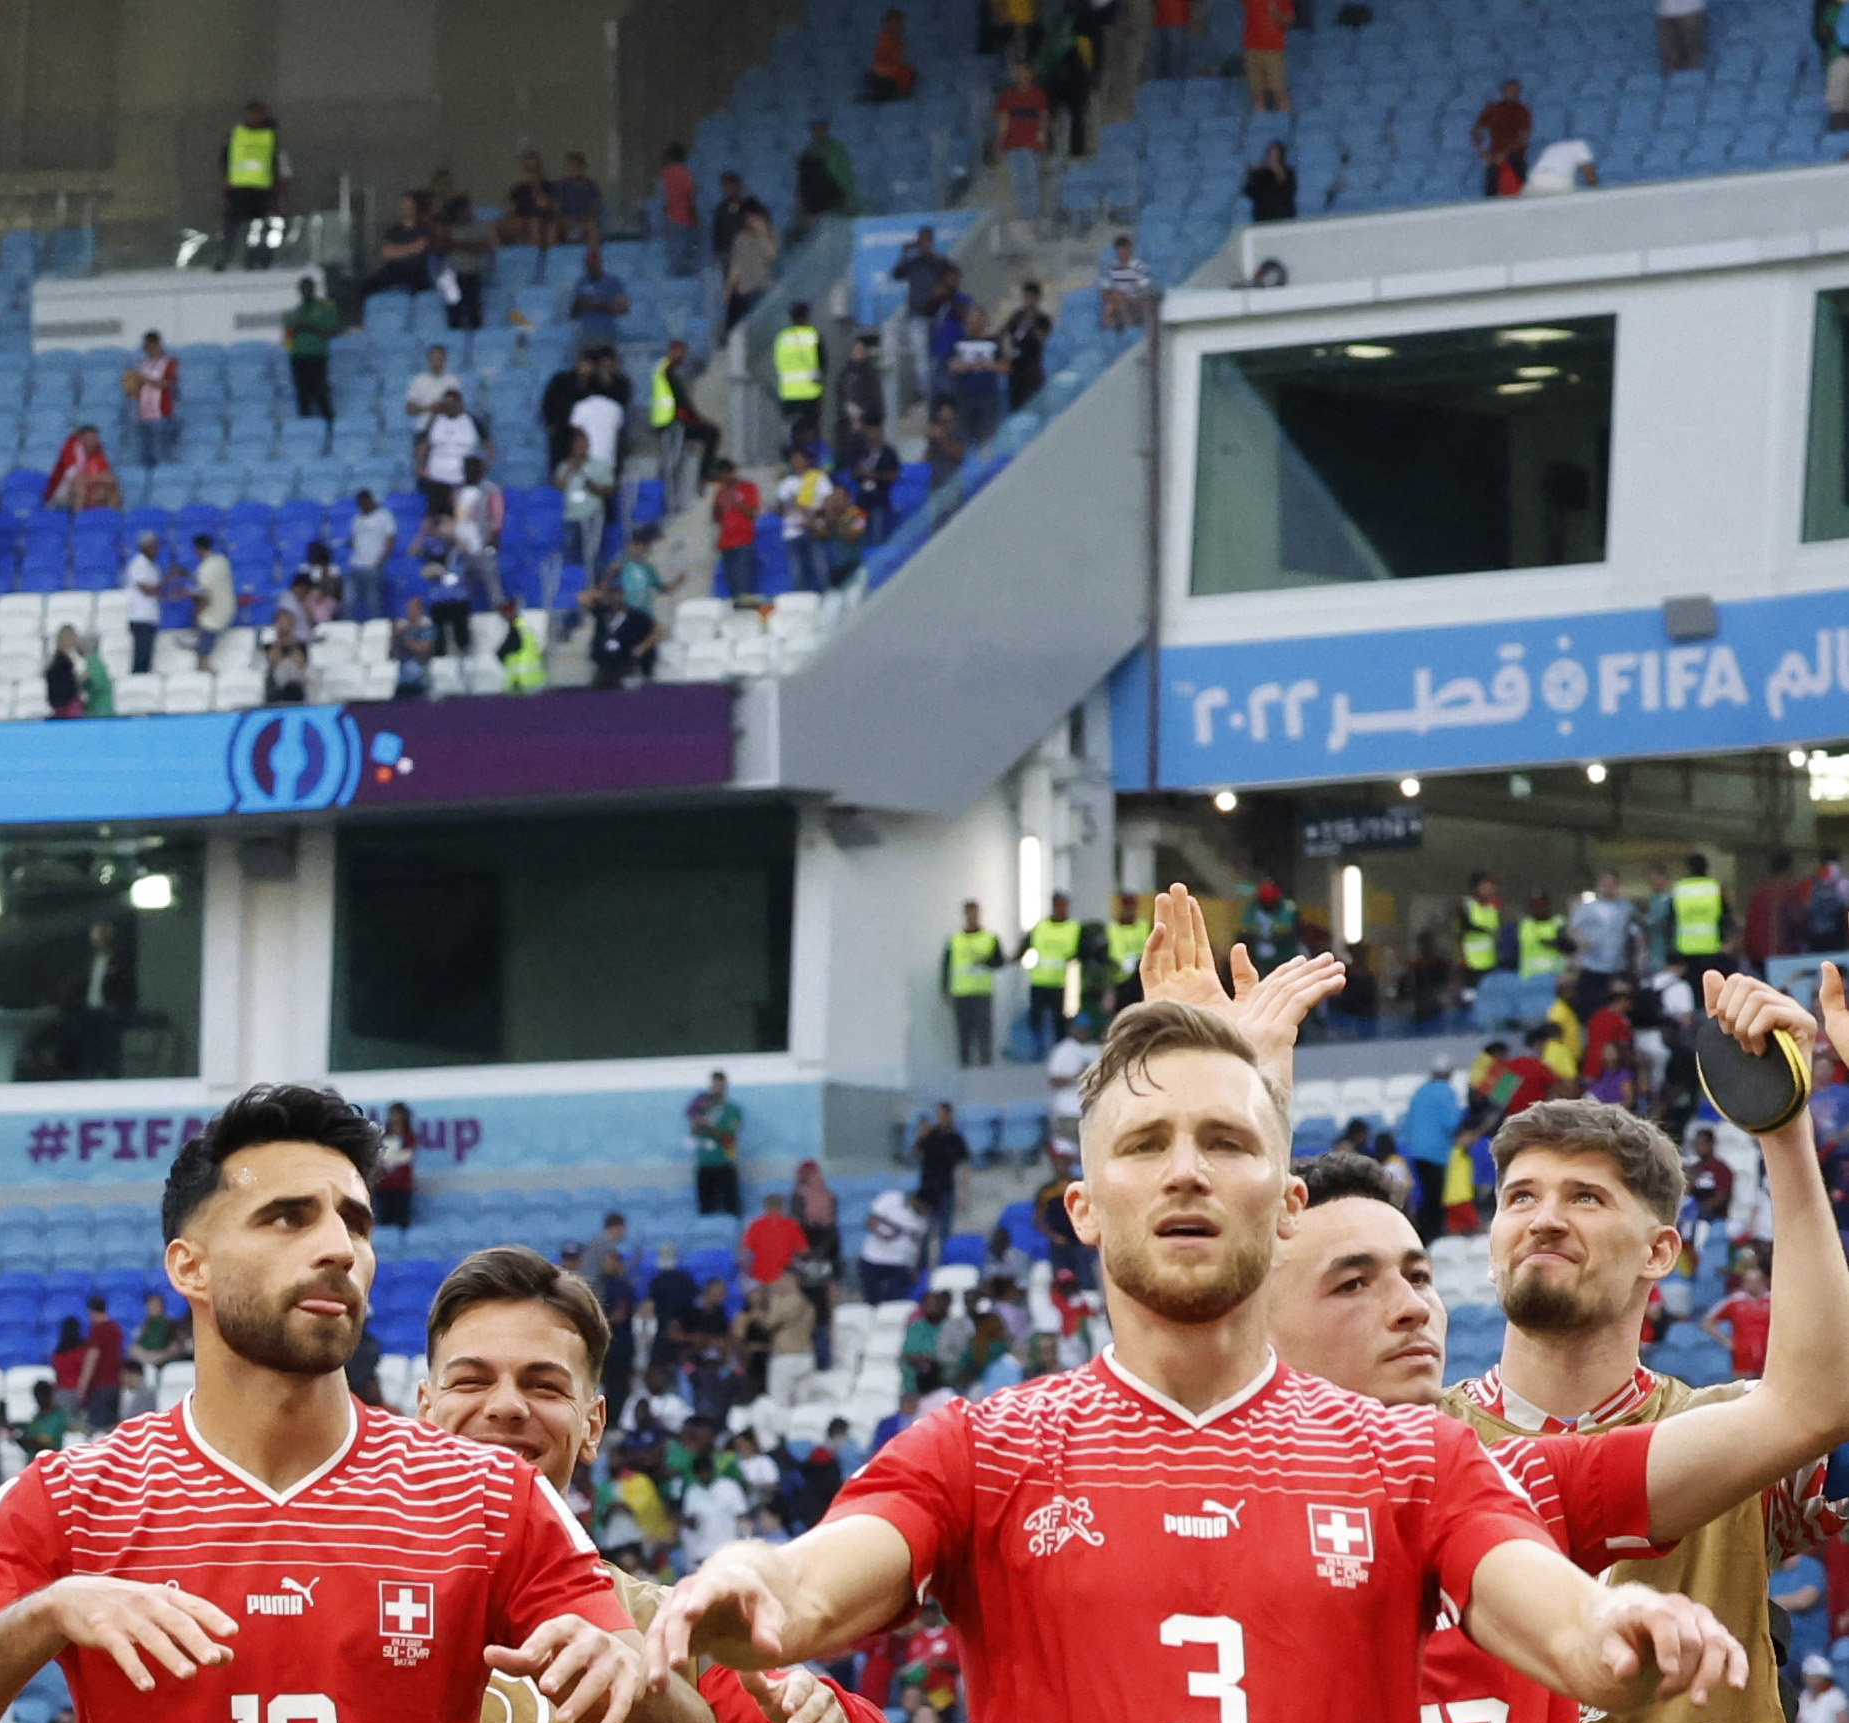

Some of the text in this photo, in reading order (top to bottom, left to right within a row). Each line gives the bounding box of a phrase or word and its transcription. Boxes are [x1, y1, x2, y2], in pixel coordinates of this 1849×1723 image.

[1600, 646, 1750, 714] FIFA
[1164, 1513, 1229, 1540] PUMA
[245, 1593, 303, 1615] PUMA
[382, 1644, 399, 1658] SUI
[406, 1646, 430, 1660] CMR
